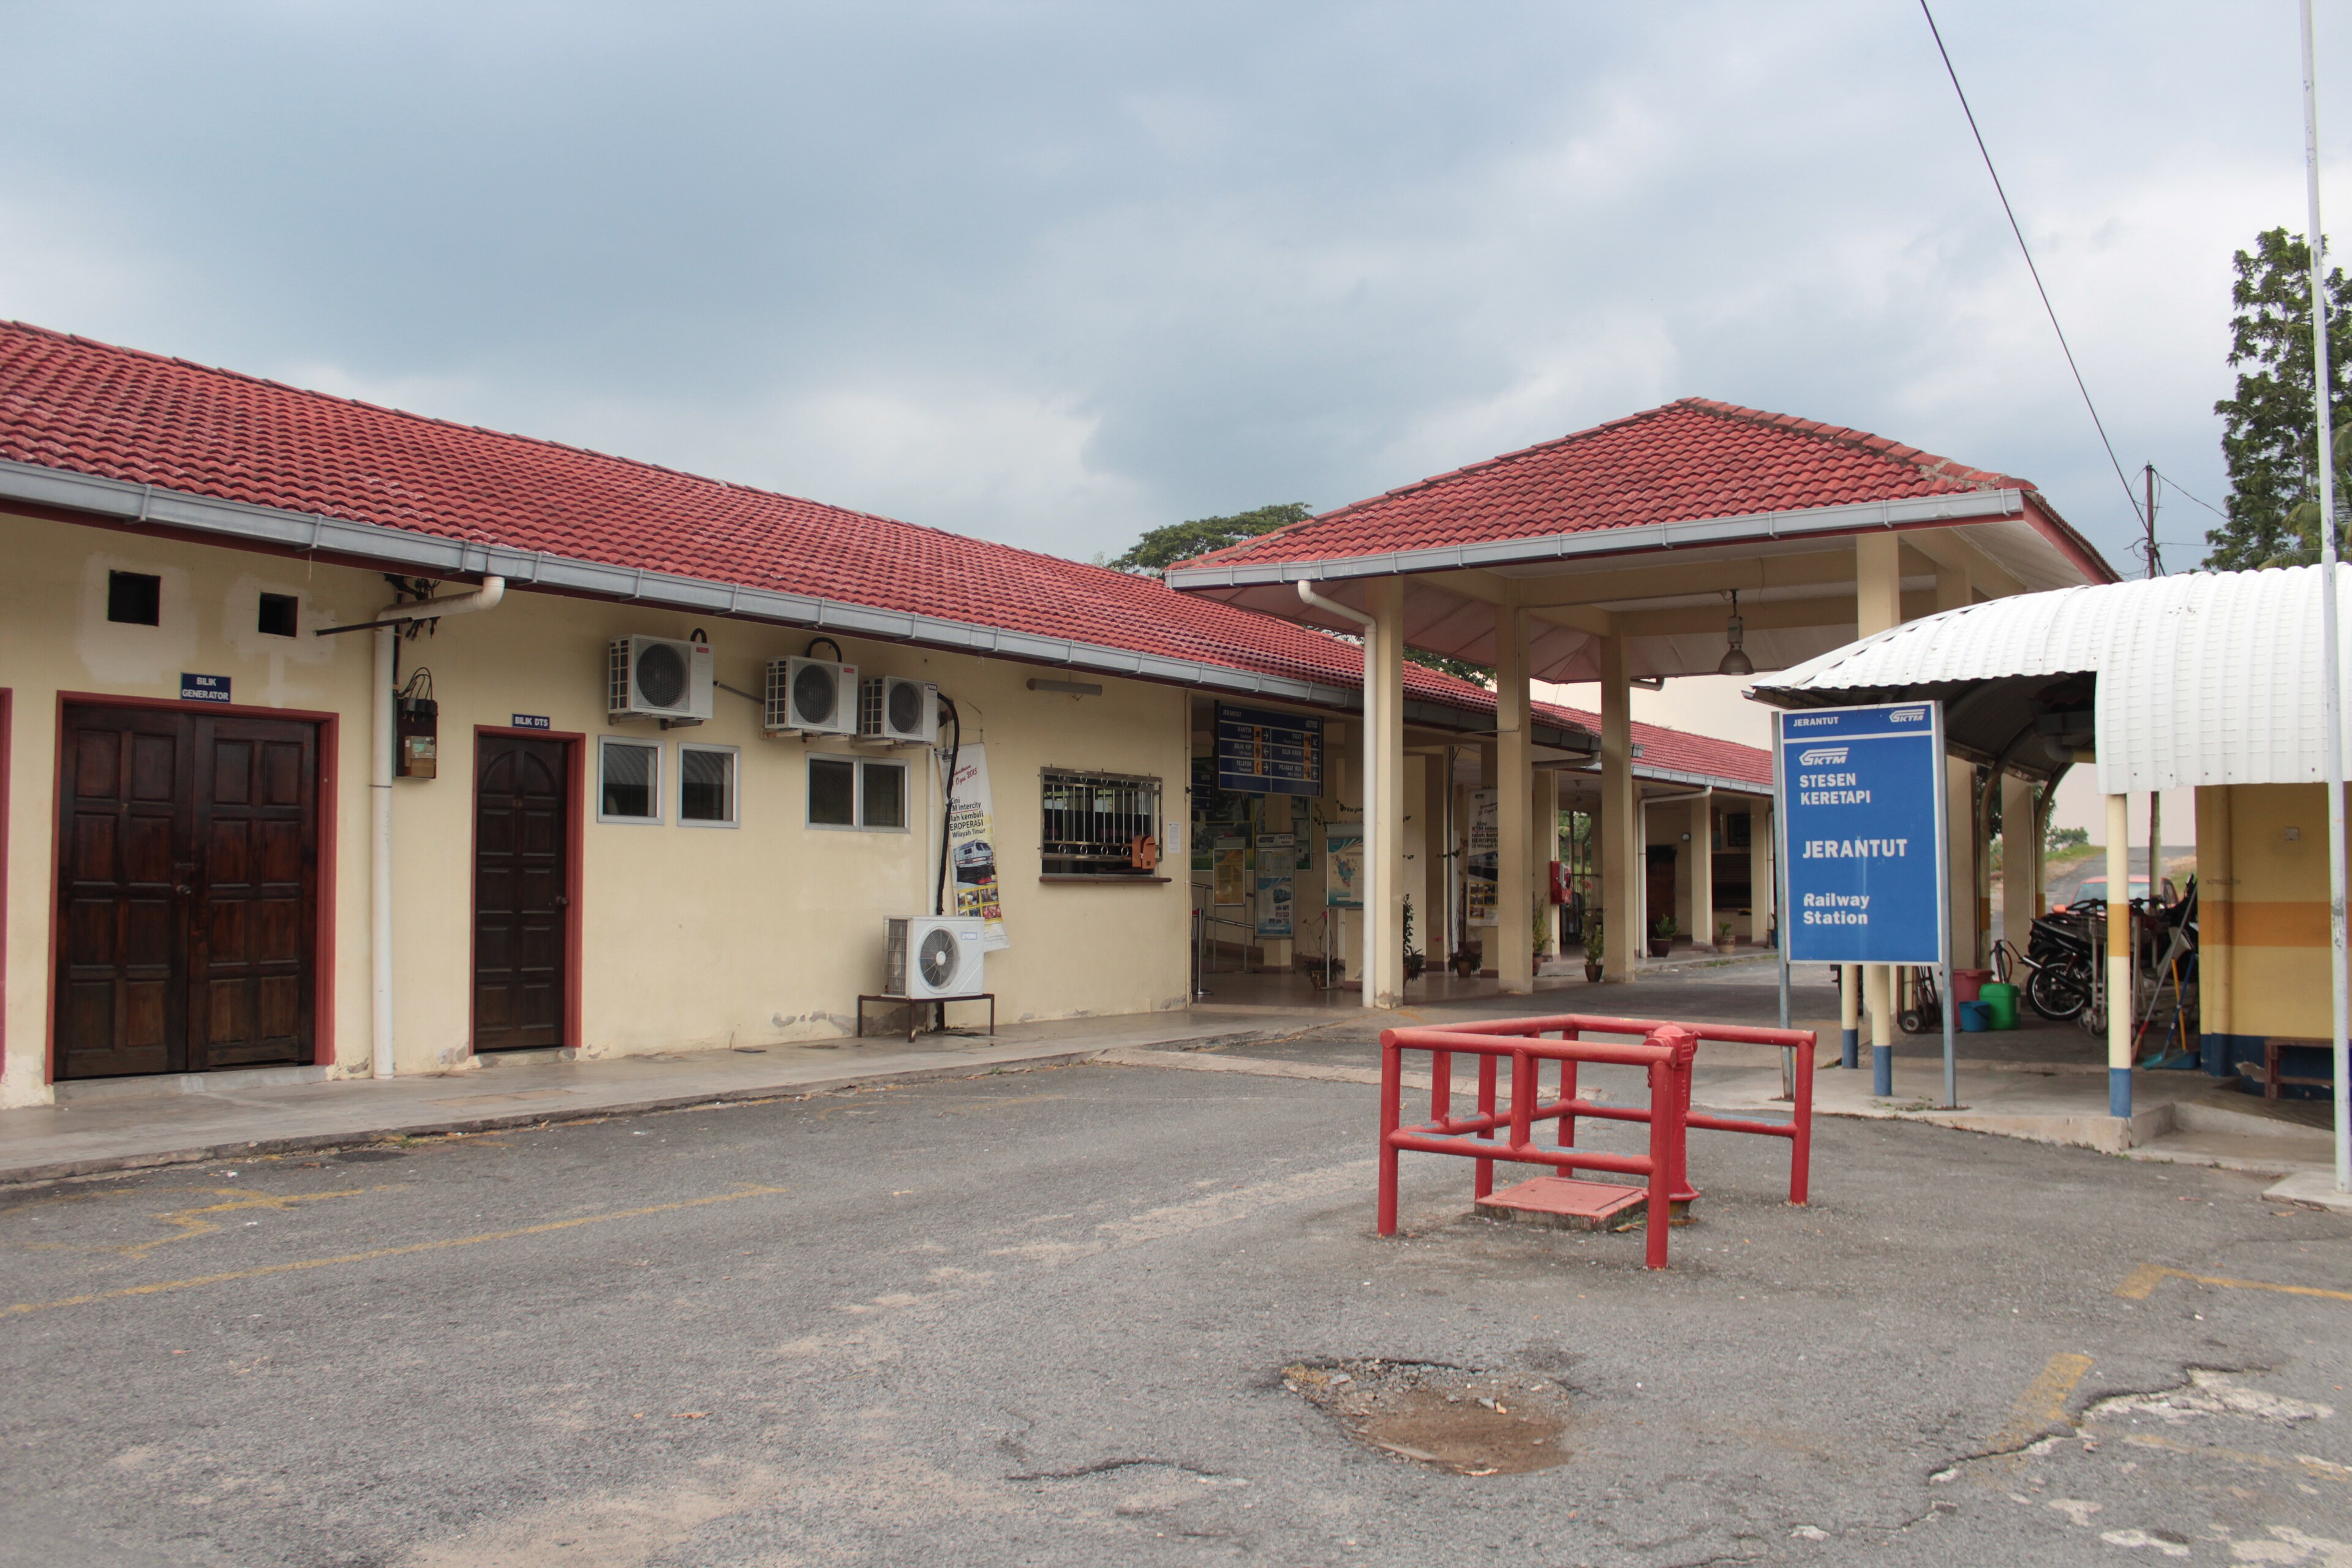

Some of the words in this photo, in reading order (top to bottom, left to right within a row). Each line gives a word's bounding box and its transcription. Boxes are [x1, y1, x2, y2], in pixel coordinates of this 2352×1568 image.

[196, 677, 217, 686] BILIK
[182, 688, 229, 700] GENERATOR
[515, 717, 533, 725] BILIK
[534, 718, 549, 727] DTS
[1793, 716, 1839, 727] JERANTUT
[966, 767, 978, 779] 2015
[1800, 773, 1856, 788] STESEN
[1800, 790, 1871, 805] KERETAPI
[958, 801, 981, 810] Intercity
[951, 813, 960, 822] lah
[960, 810, 984, 820] kembali
[949, 819, 984, 831] EROPERASI
[952, 830, 971, 839] Wilayah
[1802, 839, 1909, 858] JERANTUT
[1803, 892, 1870, 910] Railway
[1803, 910, 1869, 925] Station
